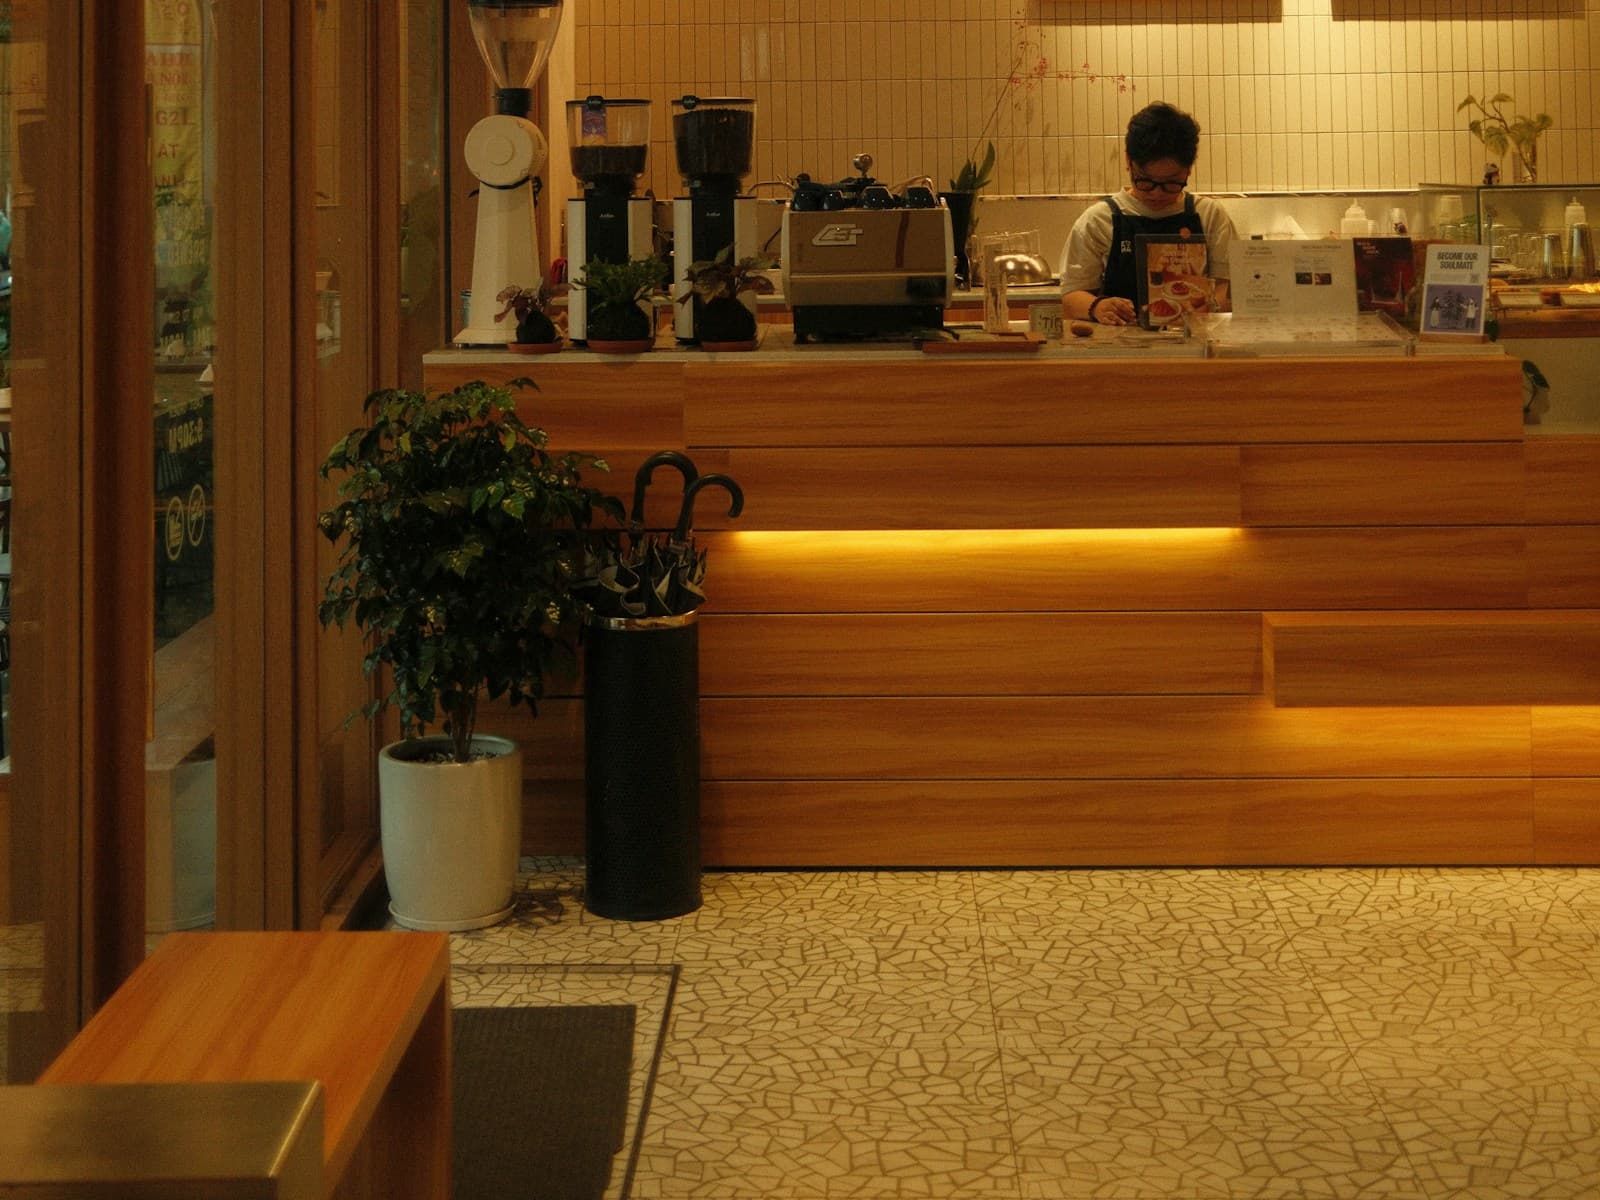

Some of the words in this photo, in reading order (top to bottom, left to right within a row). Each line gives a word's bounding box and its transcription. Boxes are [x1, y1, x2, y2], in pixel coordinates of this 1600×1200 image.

[1437, 252, 1463, 260] BECOME
[1464, 251, 1478, 260] OUR
[1440, 261, 1473, 269] SOULMATE
